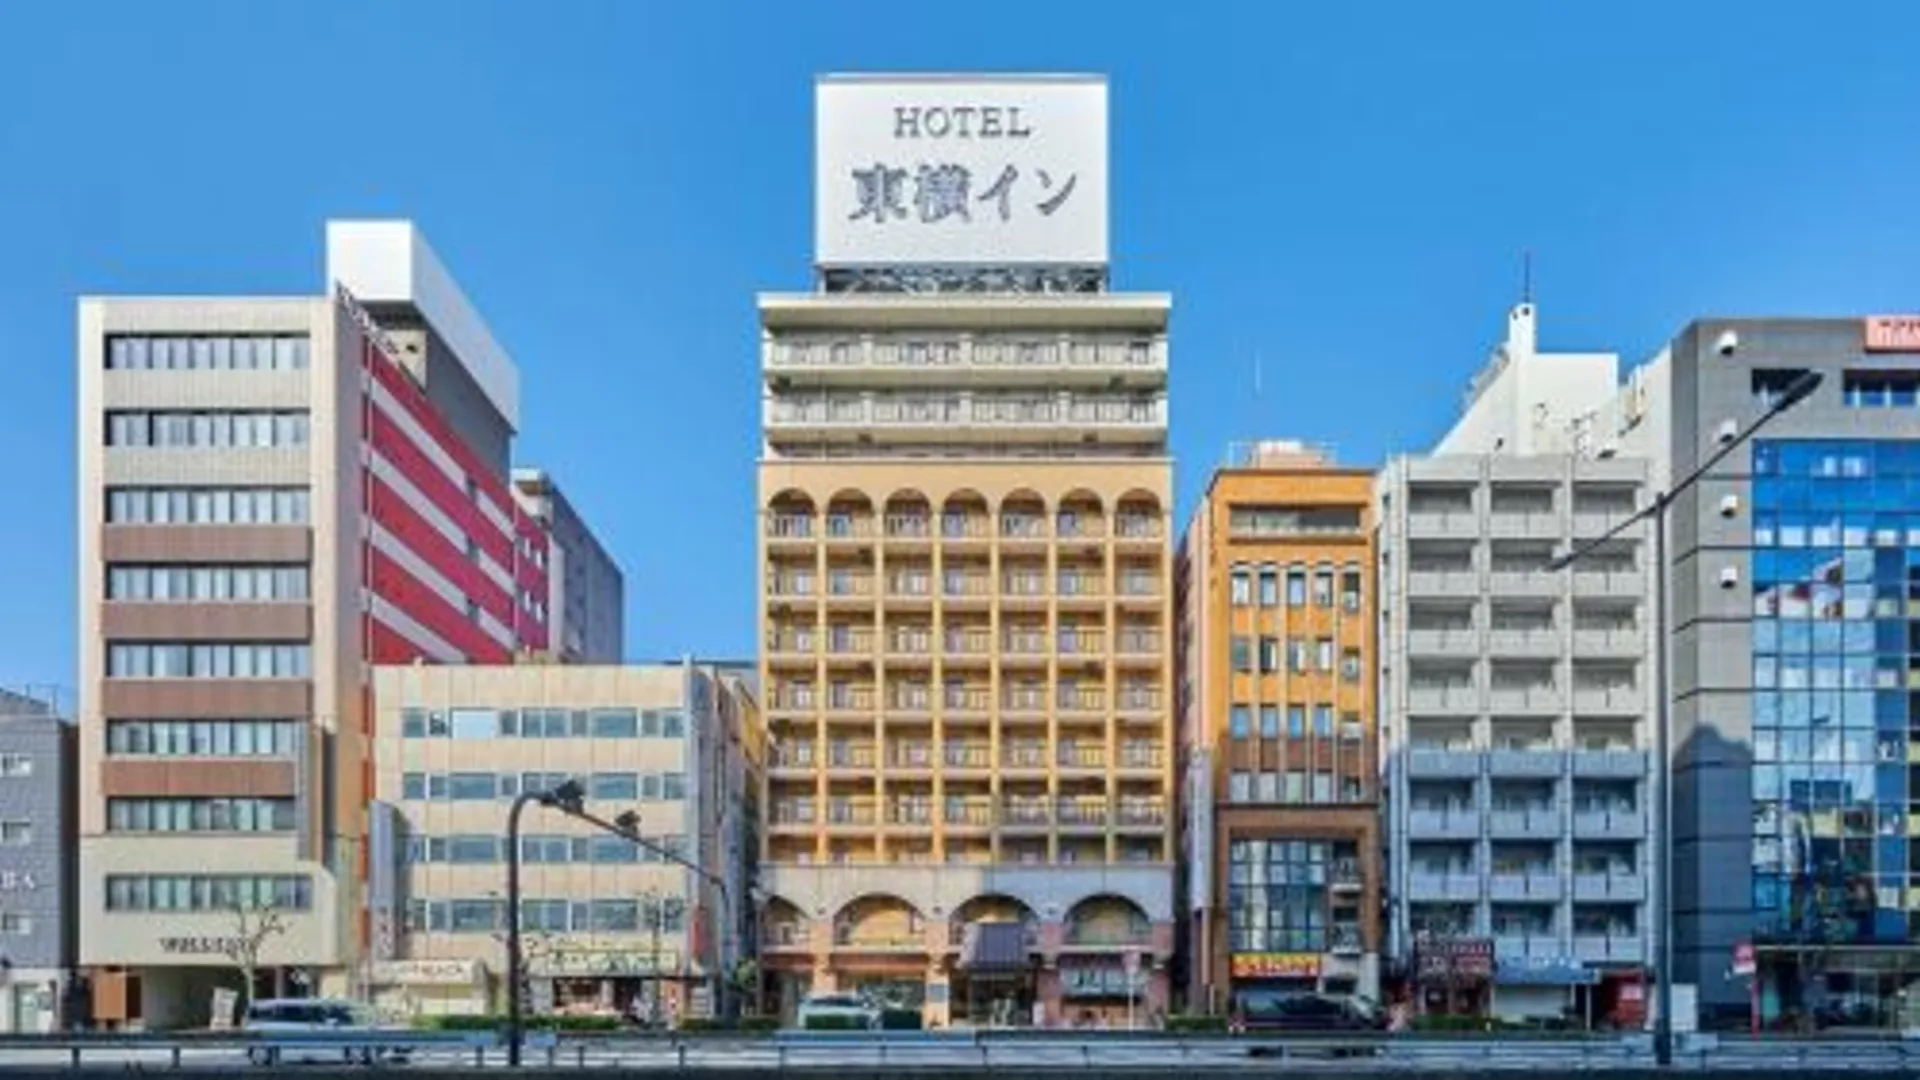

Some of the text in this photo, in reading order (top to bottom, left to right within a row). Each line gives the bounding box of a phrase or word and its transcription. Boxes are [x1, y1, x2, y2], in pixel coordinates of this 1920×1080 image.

[893, 106, 1031, 138] HOTEL
[848, 162, 1077, 224] 東横イン
